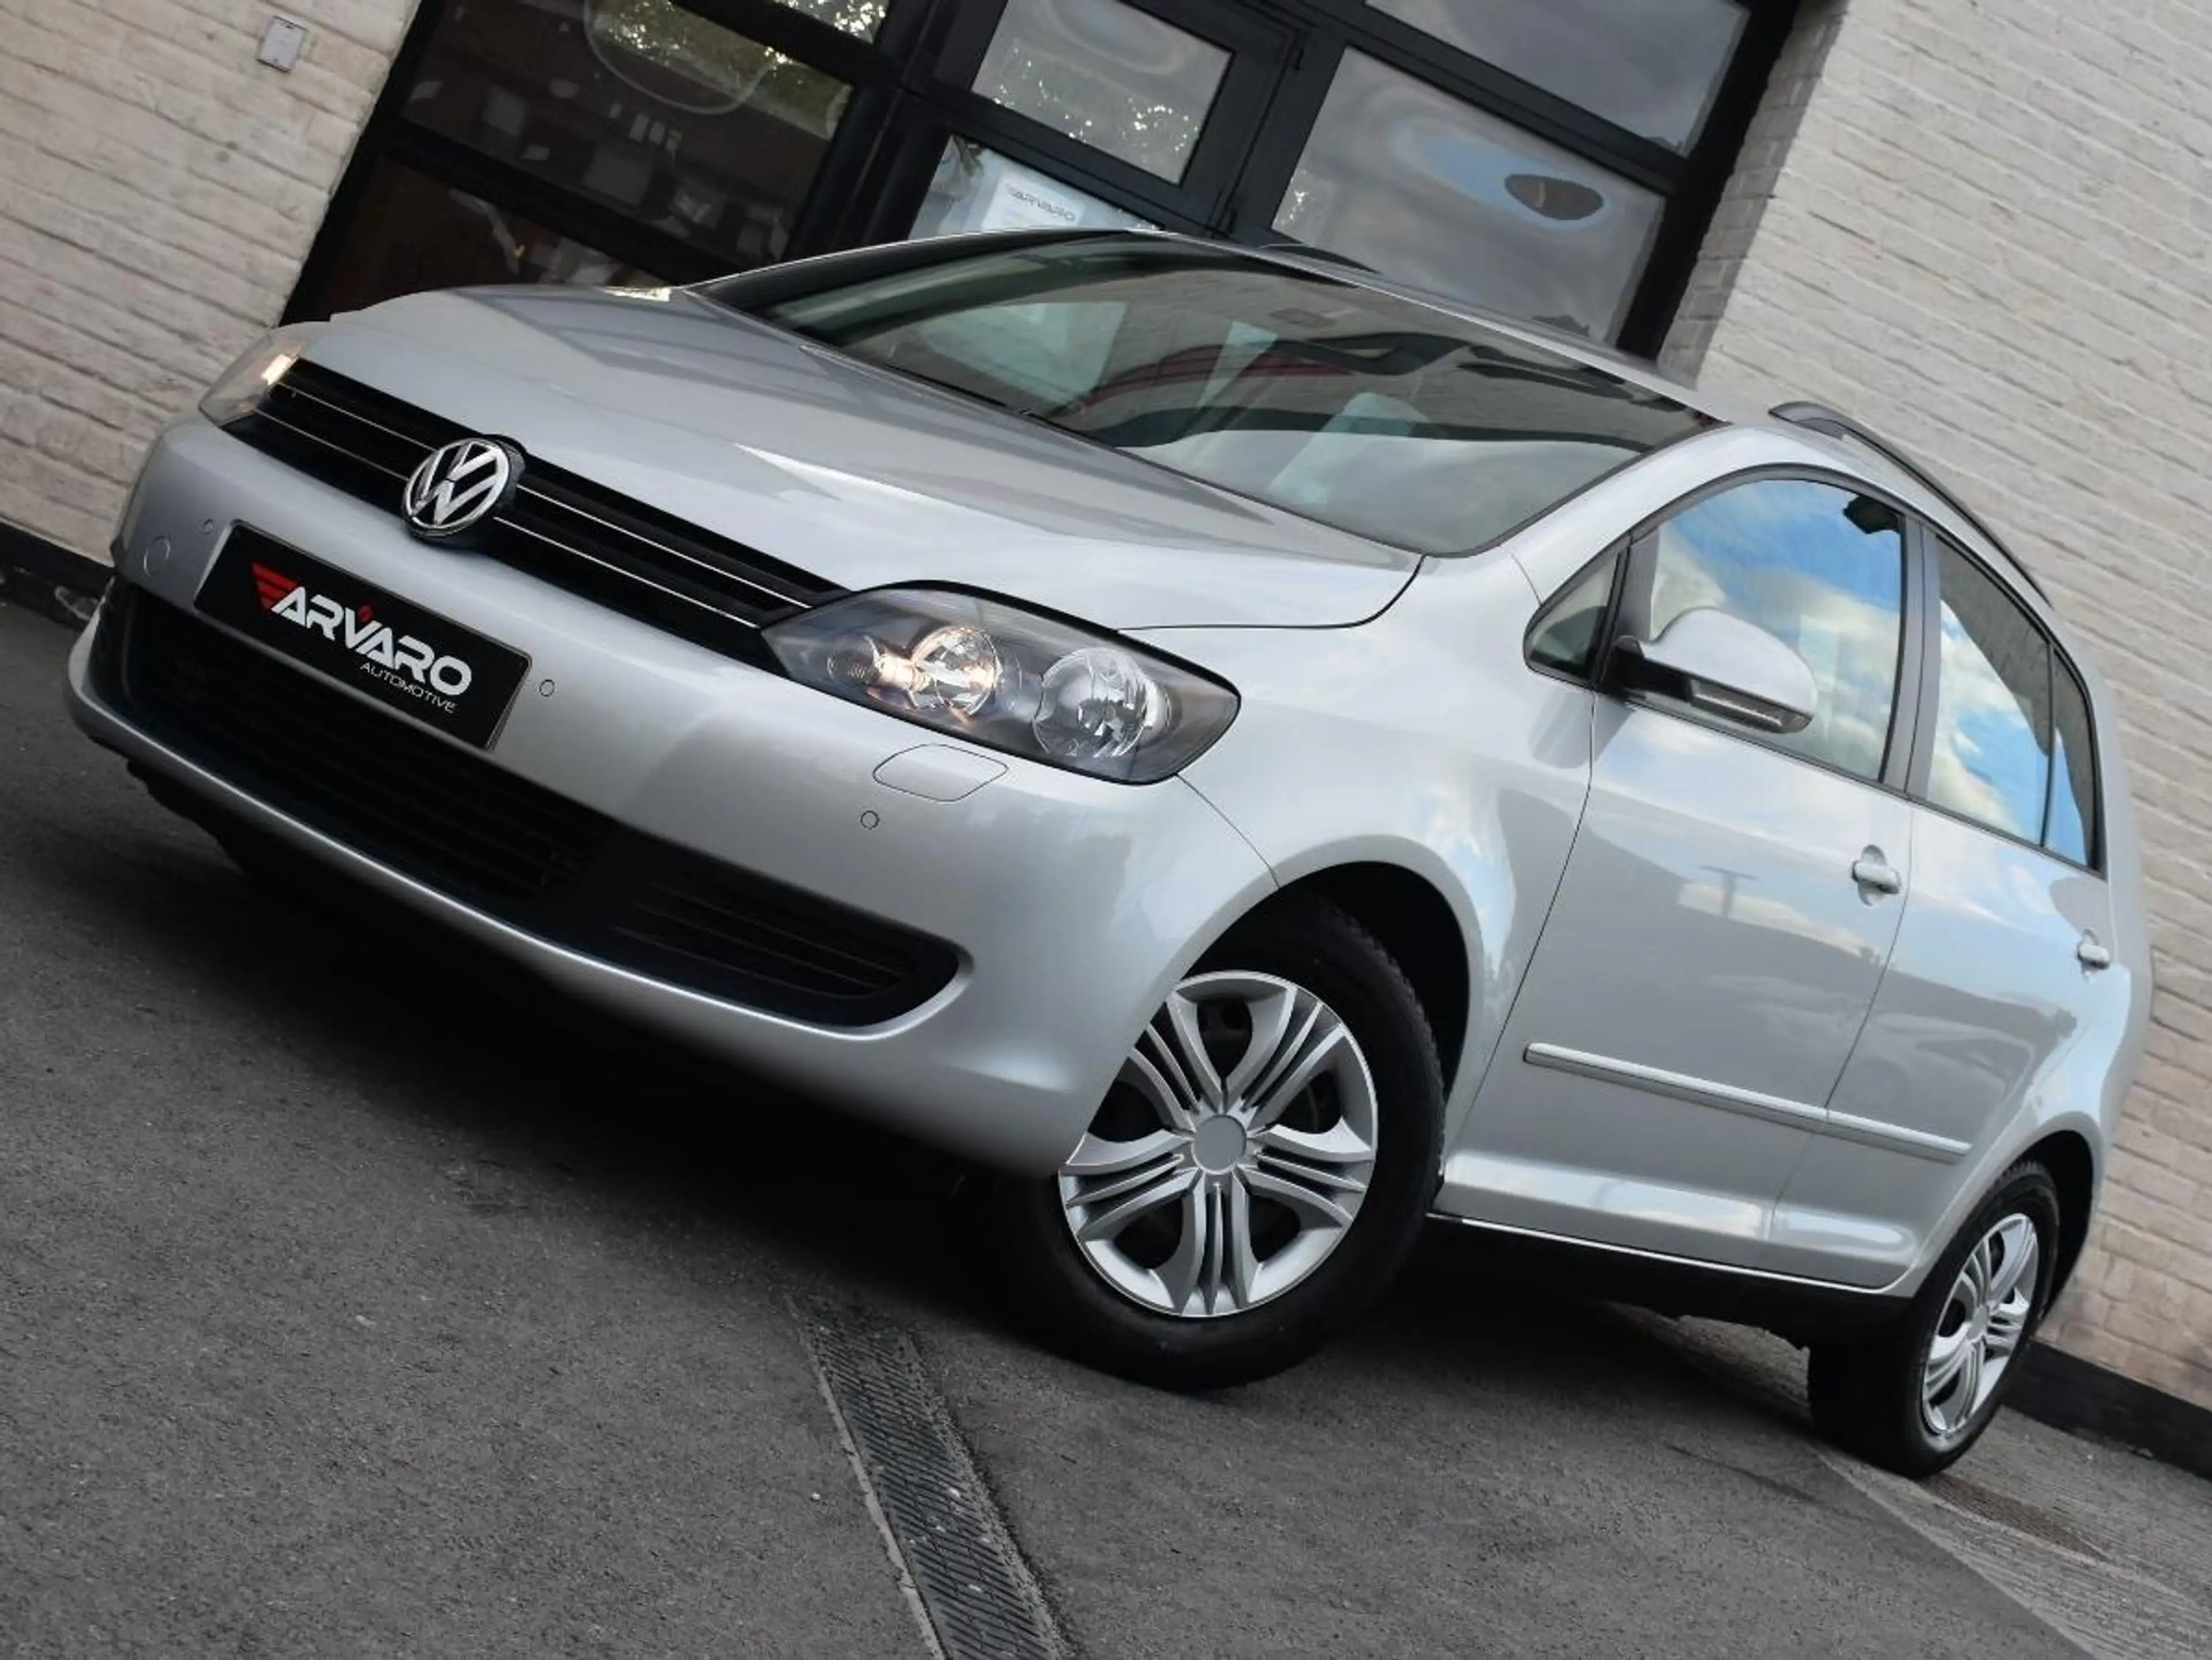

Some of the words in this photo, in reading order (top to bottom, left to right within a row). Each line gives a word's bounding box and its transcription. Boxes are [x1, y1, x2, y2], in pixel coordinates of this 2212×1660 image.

[406, 438, 509, 529] VW
[270, 586, 472, 696] ARVARO
[360, 662, 459, 714] AUTOMOTIVE
